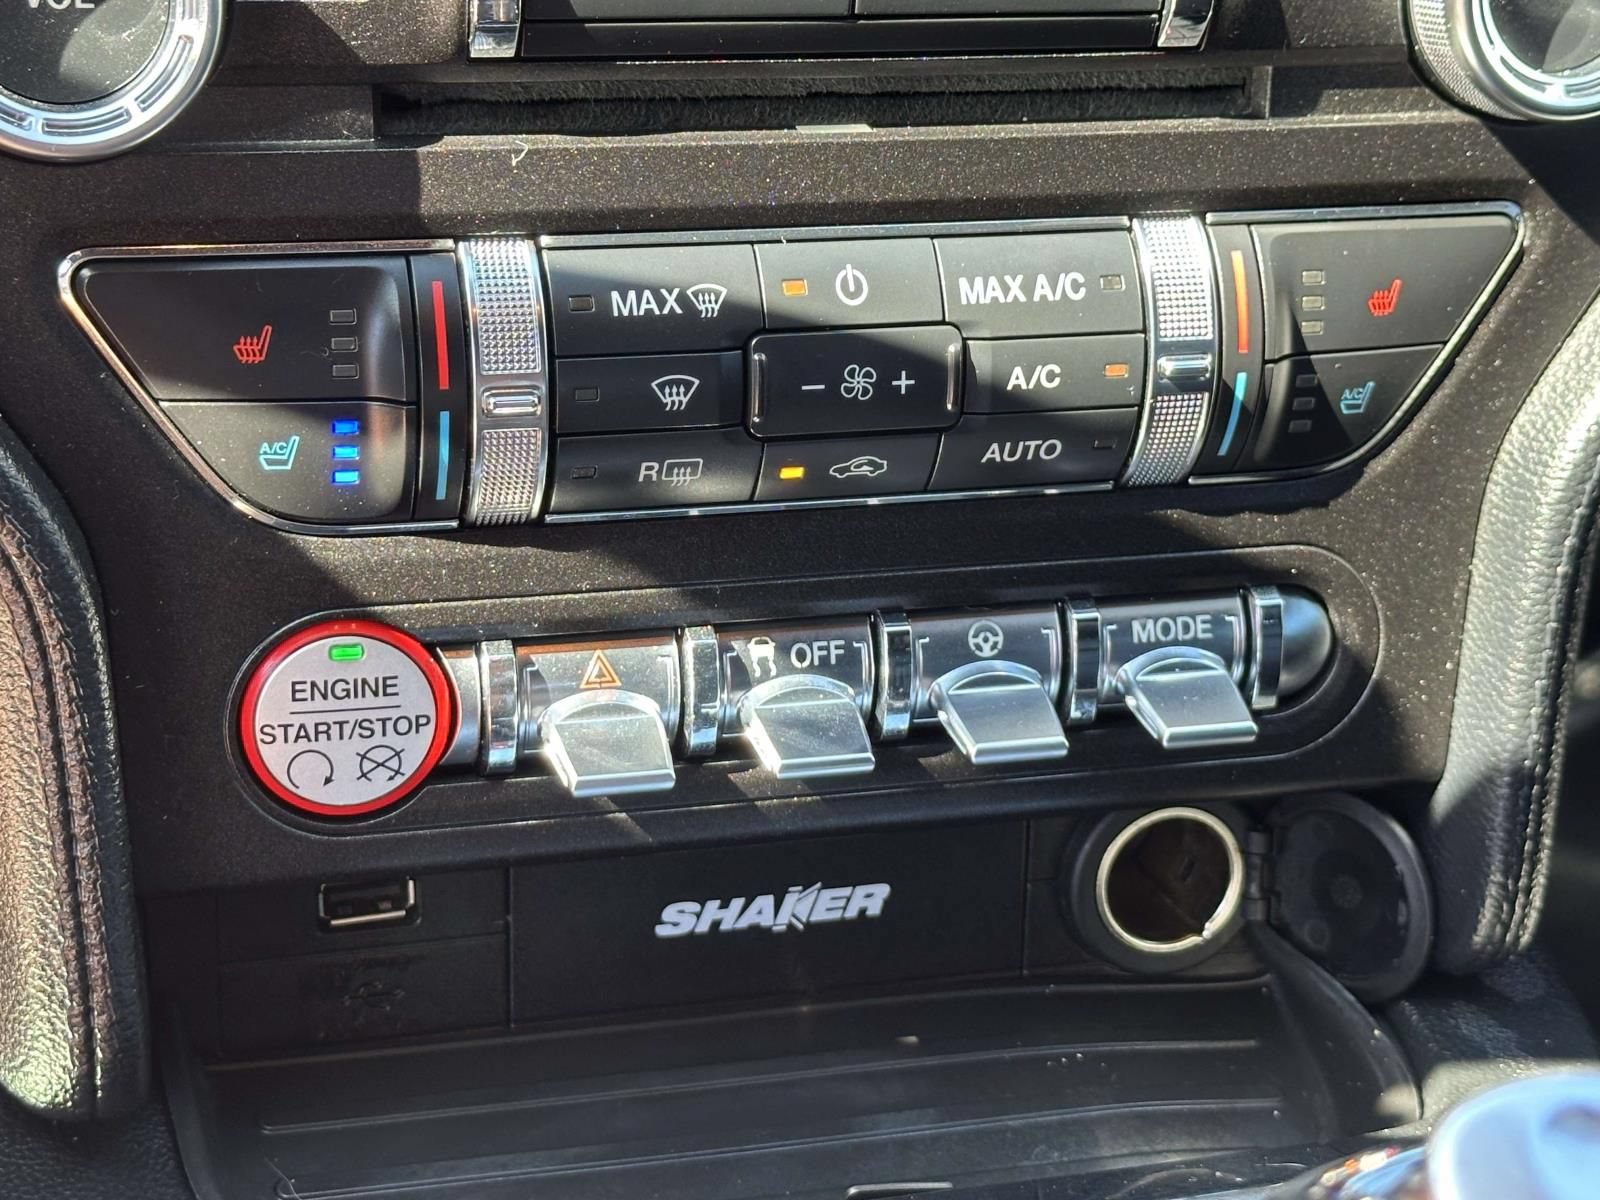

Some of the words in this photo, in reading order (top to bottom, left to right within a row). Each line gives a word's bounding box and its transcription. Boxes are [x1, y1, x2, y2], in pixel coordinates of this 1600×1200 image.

[610, 287, 684, 317] MAX
[958, 275, 1027, 305] MAX
[1033, 272, 1087, 302] A/C
[1006, 364, 1062, 390] A/C
[260, 441, 288, 454] A/C
[981, 439, 1063, 463] AUTO
[638, 461, 660, 482] R
[1131, 614, 1214, 644] MODE
[790, 639, 846, 669] OFF
[290, 675, 400, 703] ENGINE
[259, 714, 432, 745] START/STOP
[654, 881, 892, 939] SHAKER
